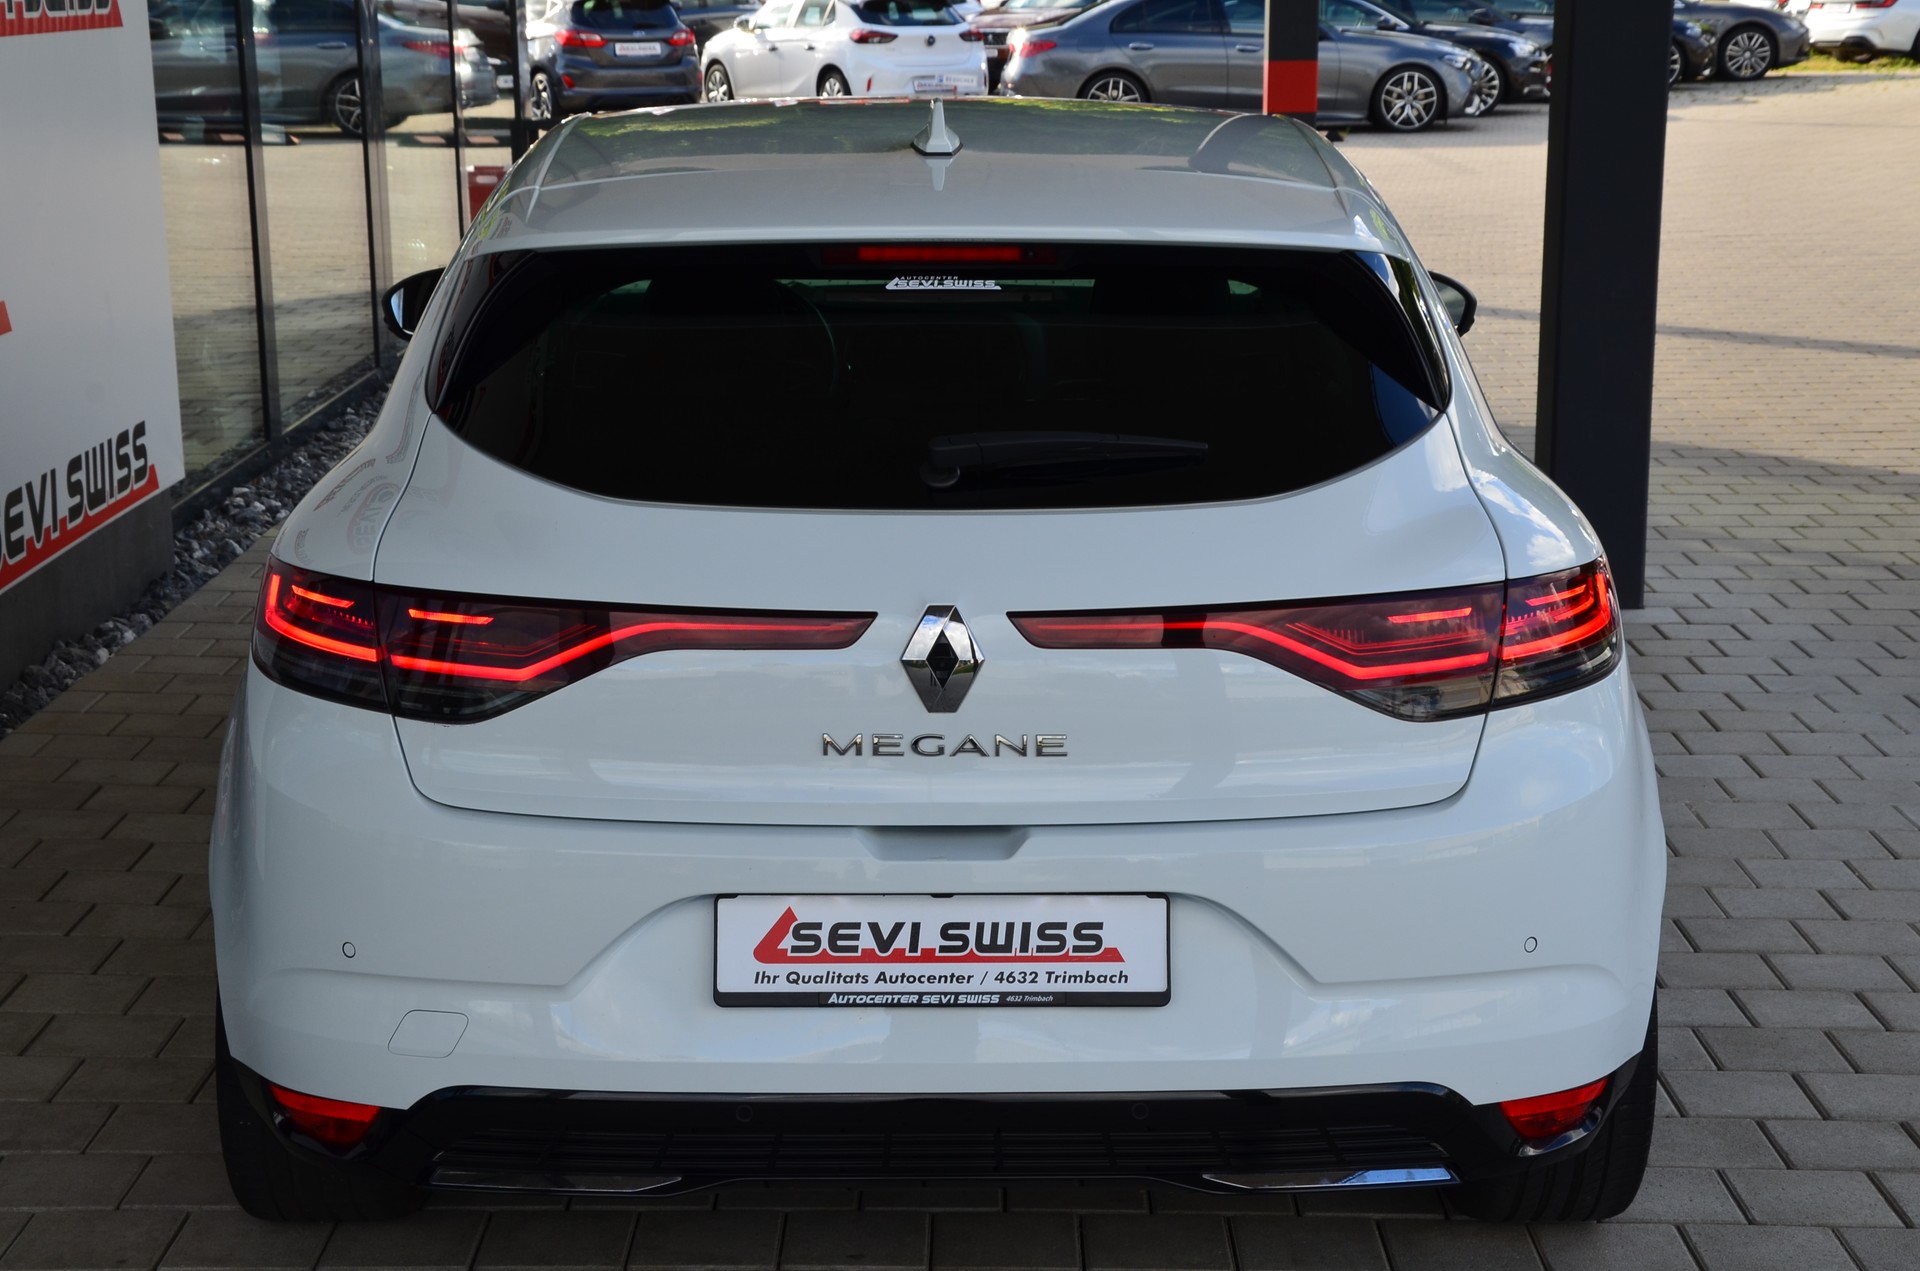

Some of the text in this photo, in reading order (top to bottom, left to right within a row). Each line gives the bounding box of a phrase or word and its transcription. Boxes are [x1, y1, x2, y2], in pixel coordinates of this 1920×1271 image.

[897, 279, 996, 288] SEVI SWISS
[0, 420, 148, 561] EVI SWISS
[822, 733, 1068, 757] MEGANE
[790, 921, 1104, 954] SEVI SWISS
[753, 970, 1129, 986] Ihr Qualitats Autocenter / 4632 Trimbach
[921, 994, 956, 1004] SEVI
[957, 994, 1000, 1004] SWISS
[1023, 994, 1054, 1002] Trimbach
